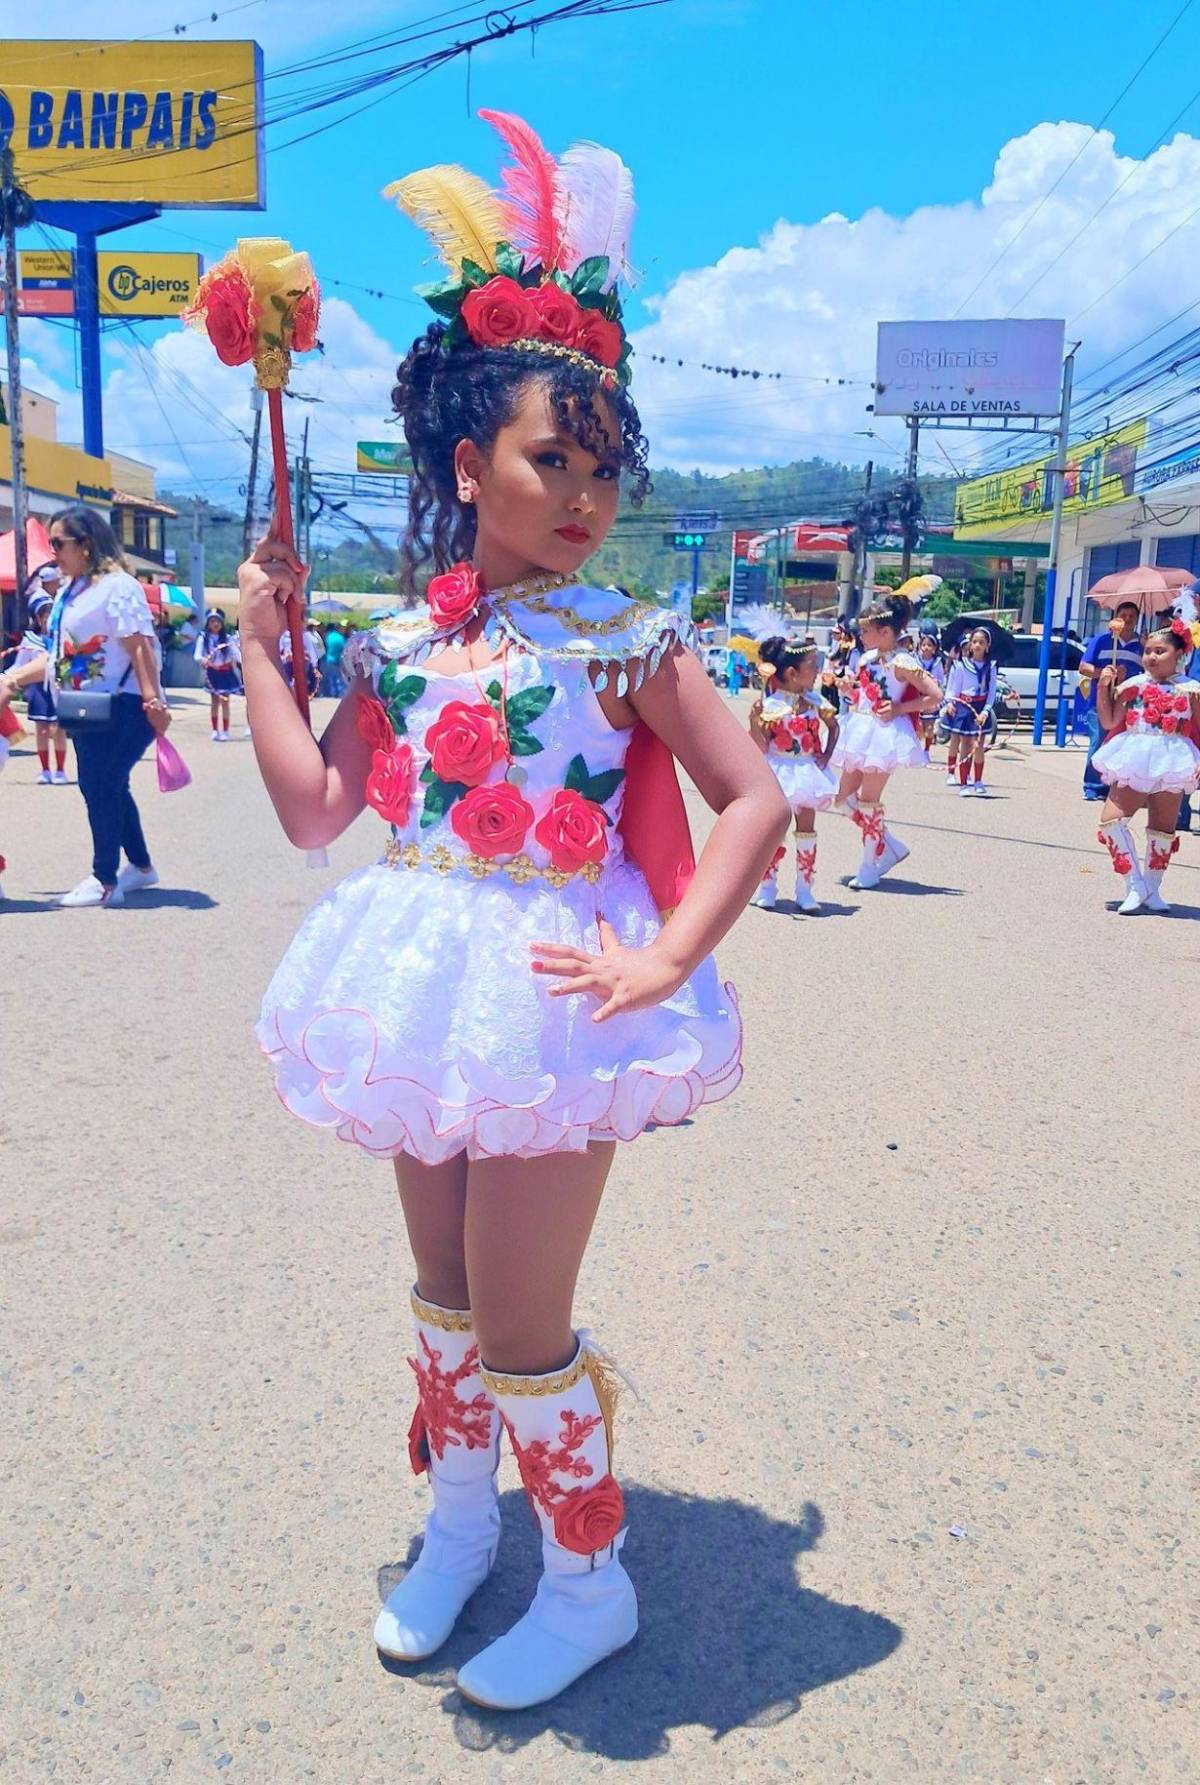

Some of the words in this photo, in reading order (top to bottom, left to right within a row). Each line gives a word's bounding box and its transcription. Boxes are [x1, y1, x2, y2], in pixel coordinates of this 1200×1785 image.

[28, 90, 217, 150] BANPAIS
[132, 276, 190, 295] Cajeros
[169, 294, 188, 303] ATM
[898, 347, 1000, 371] Originales
[912, 400, 946, 412] SALA
[950, 400, 967, 412] DE
[971, 400, 1021, 412] VENTAS
